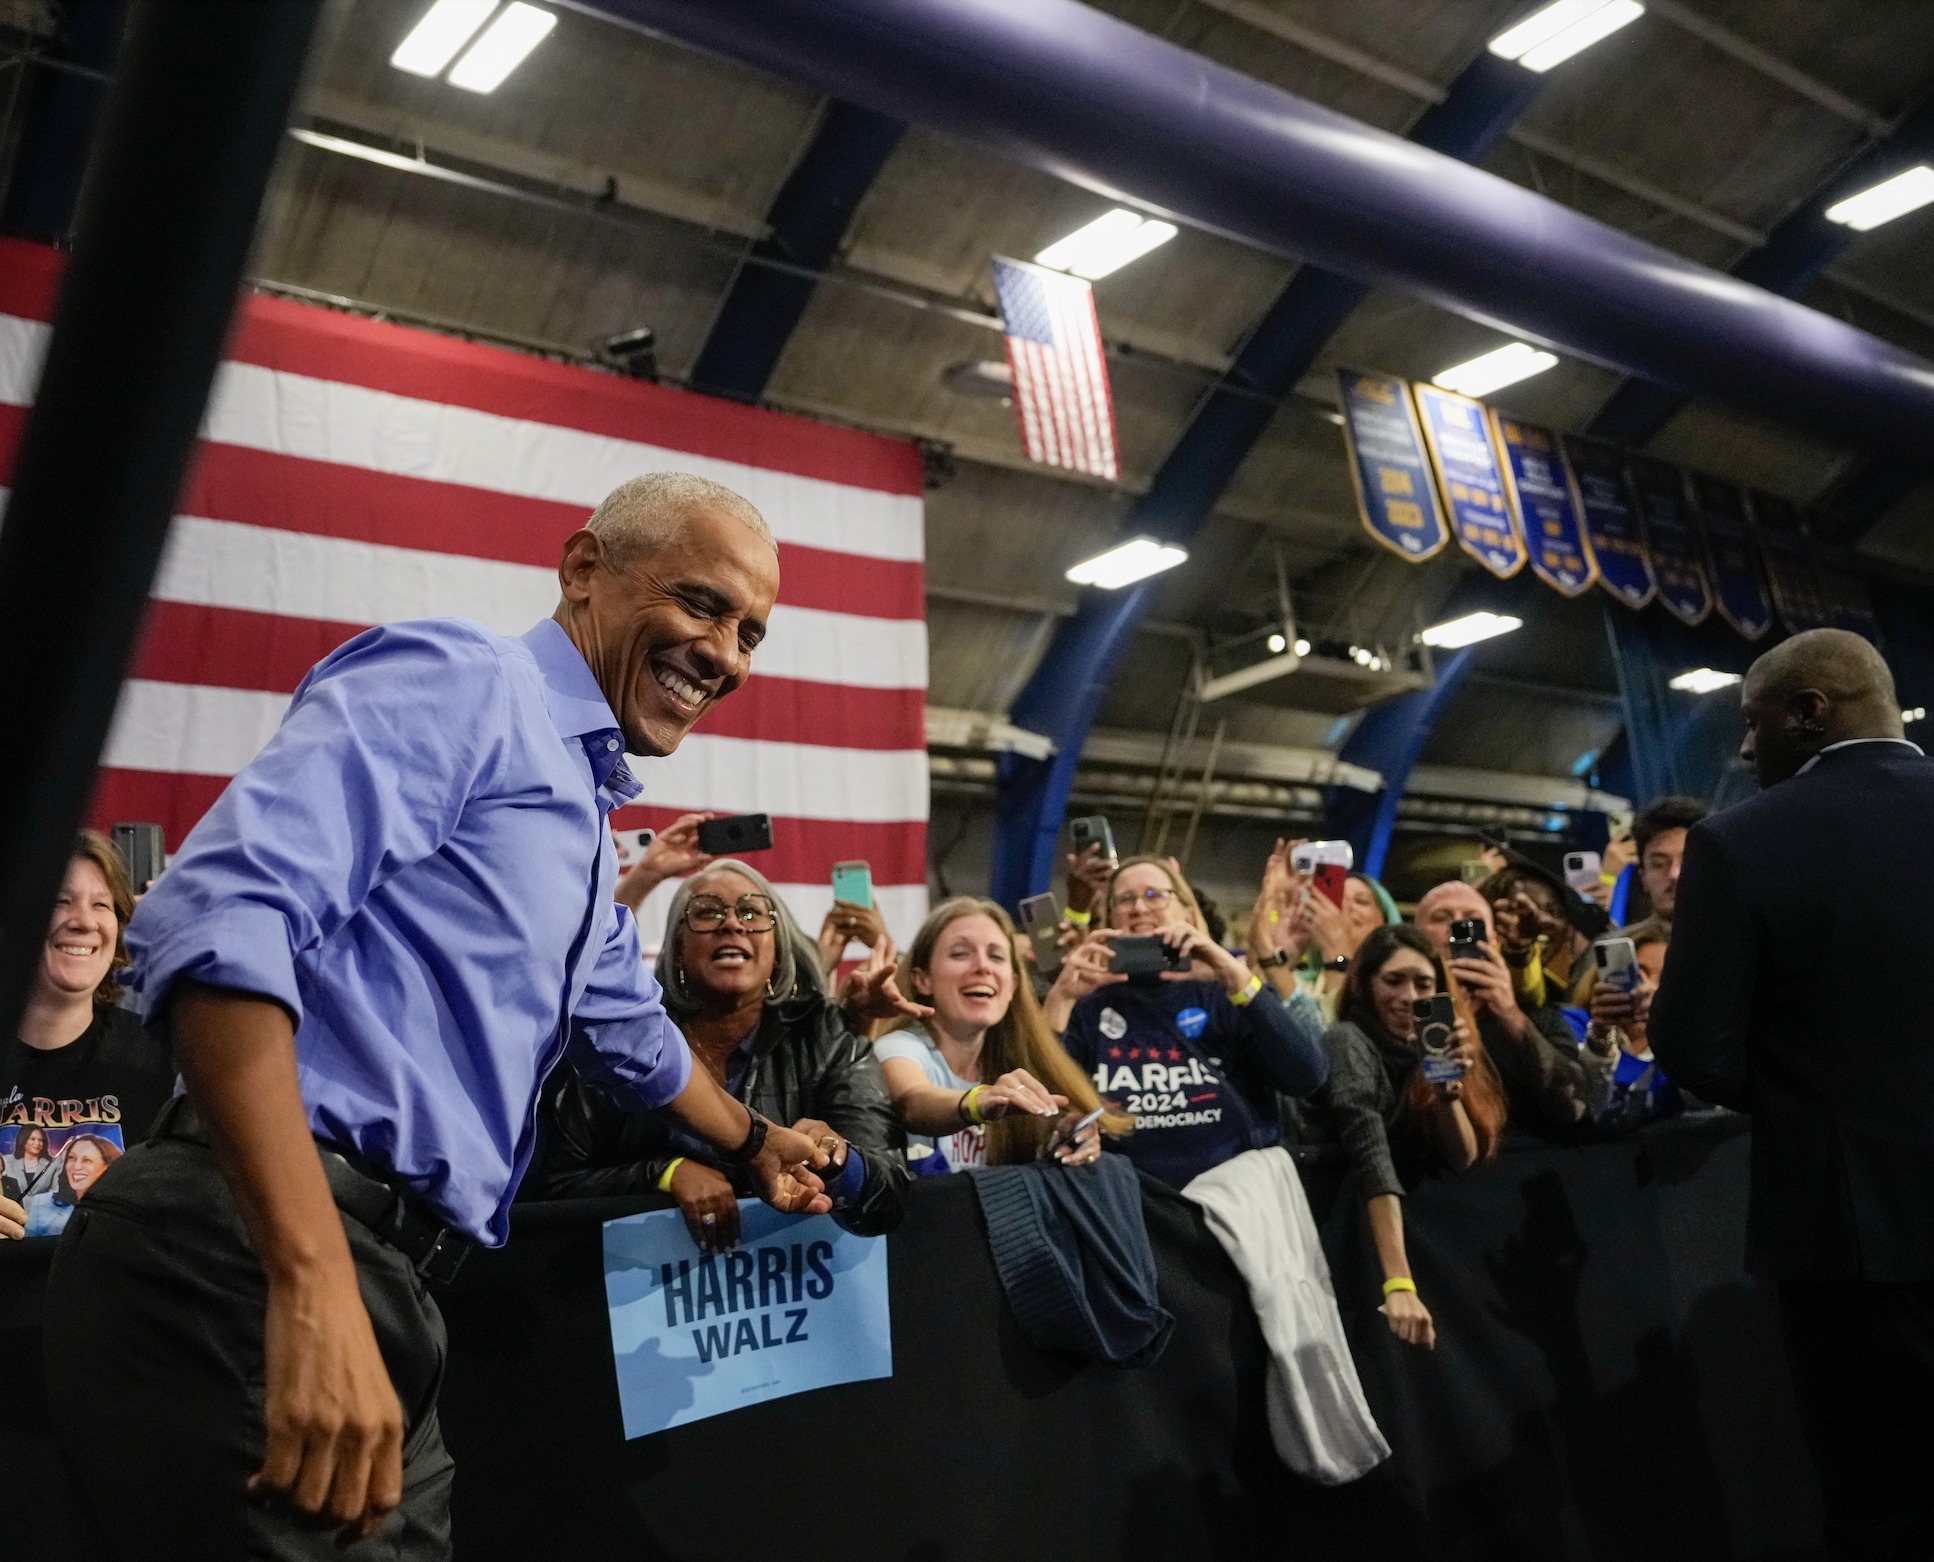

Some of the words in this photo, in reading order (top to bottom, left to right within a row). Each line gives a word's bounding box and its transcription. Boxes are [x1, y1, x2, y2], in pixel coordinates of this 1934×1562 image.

[1127, 1091, 1189, 1113] 2024
[1134, 1108, 1222, 1131] DEMOCRACY
[661, 1240, 834, 1328] HARRIS
[692, 1308, 809, 1364] WALZ
